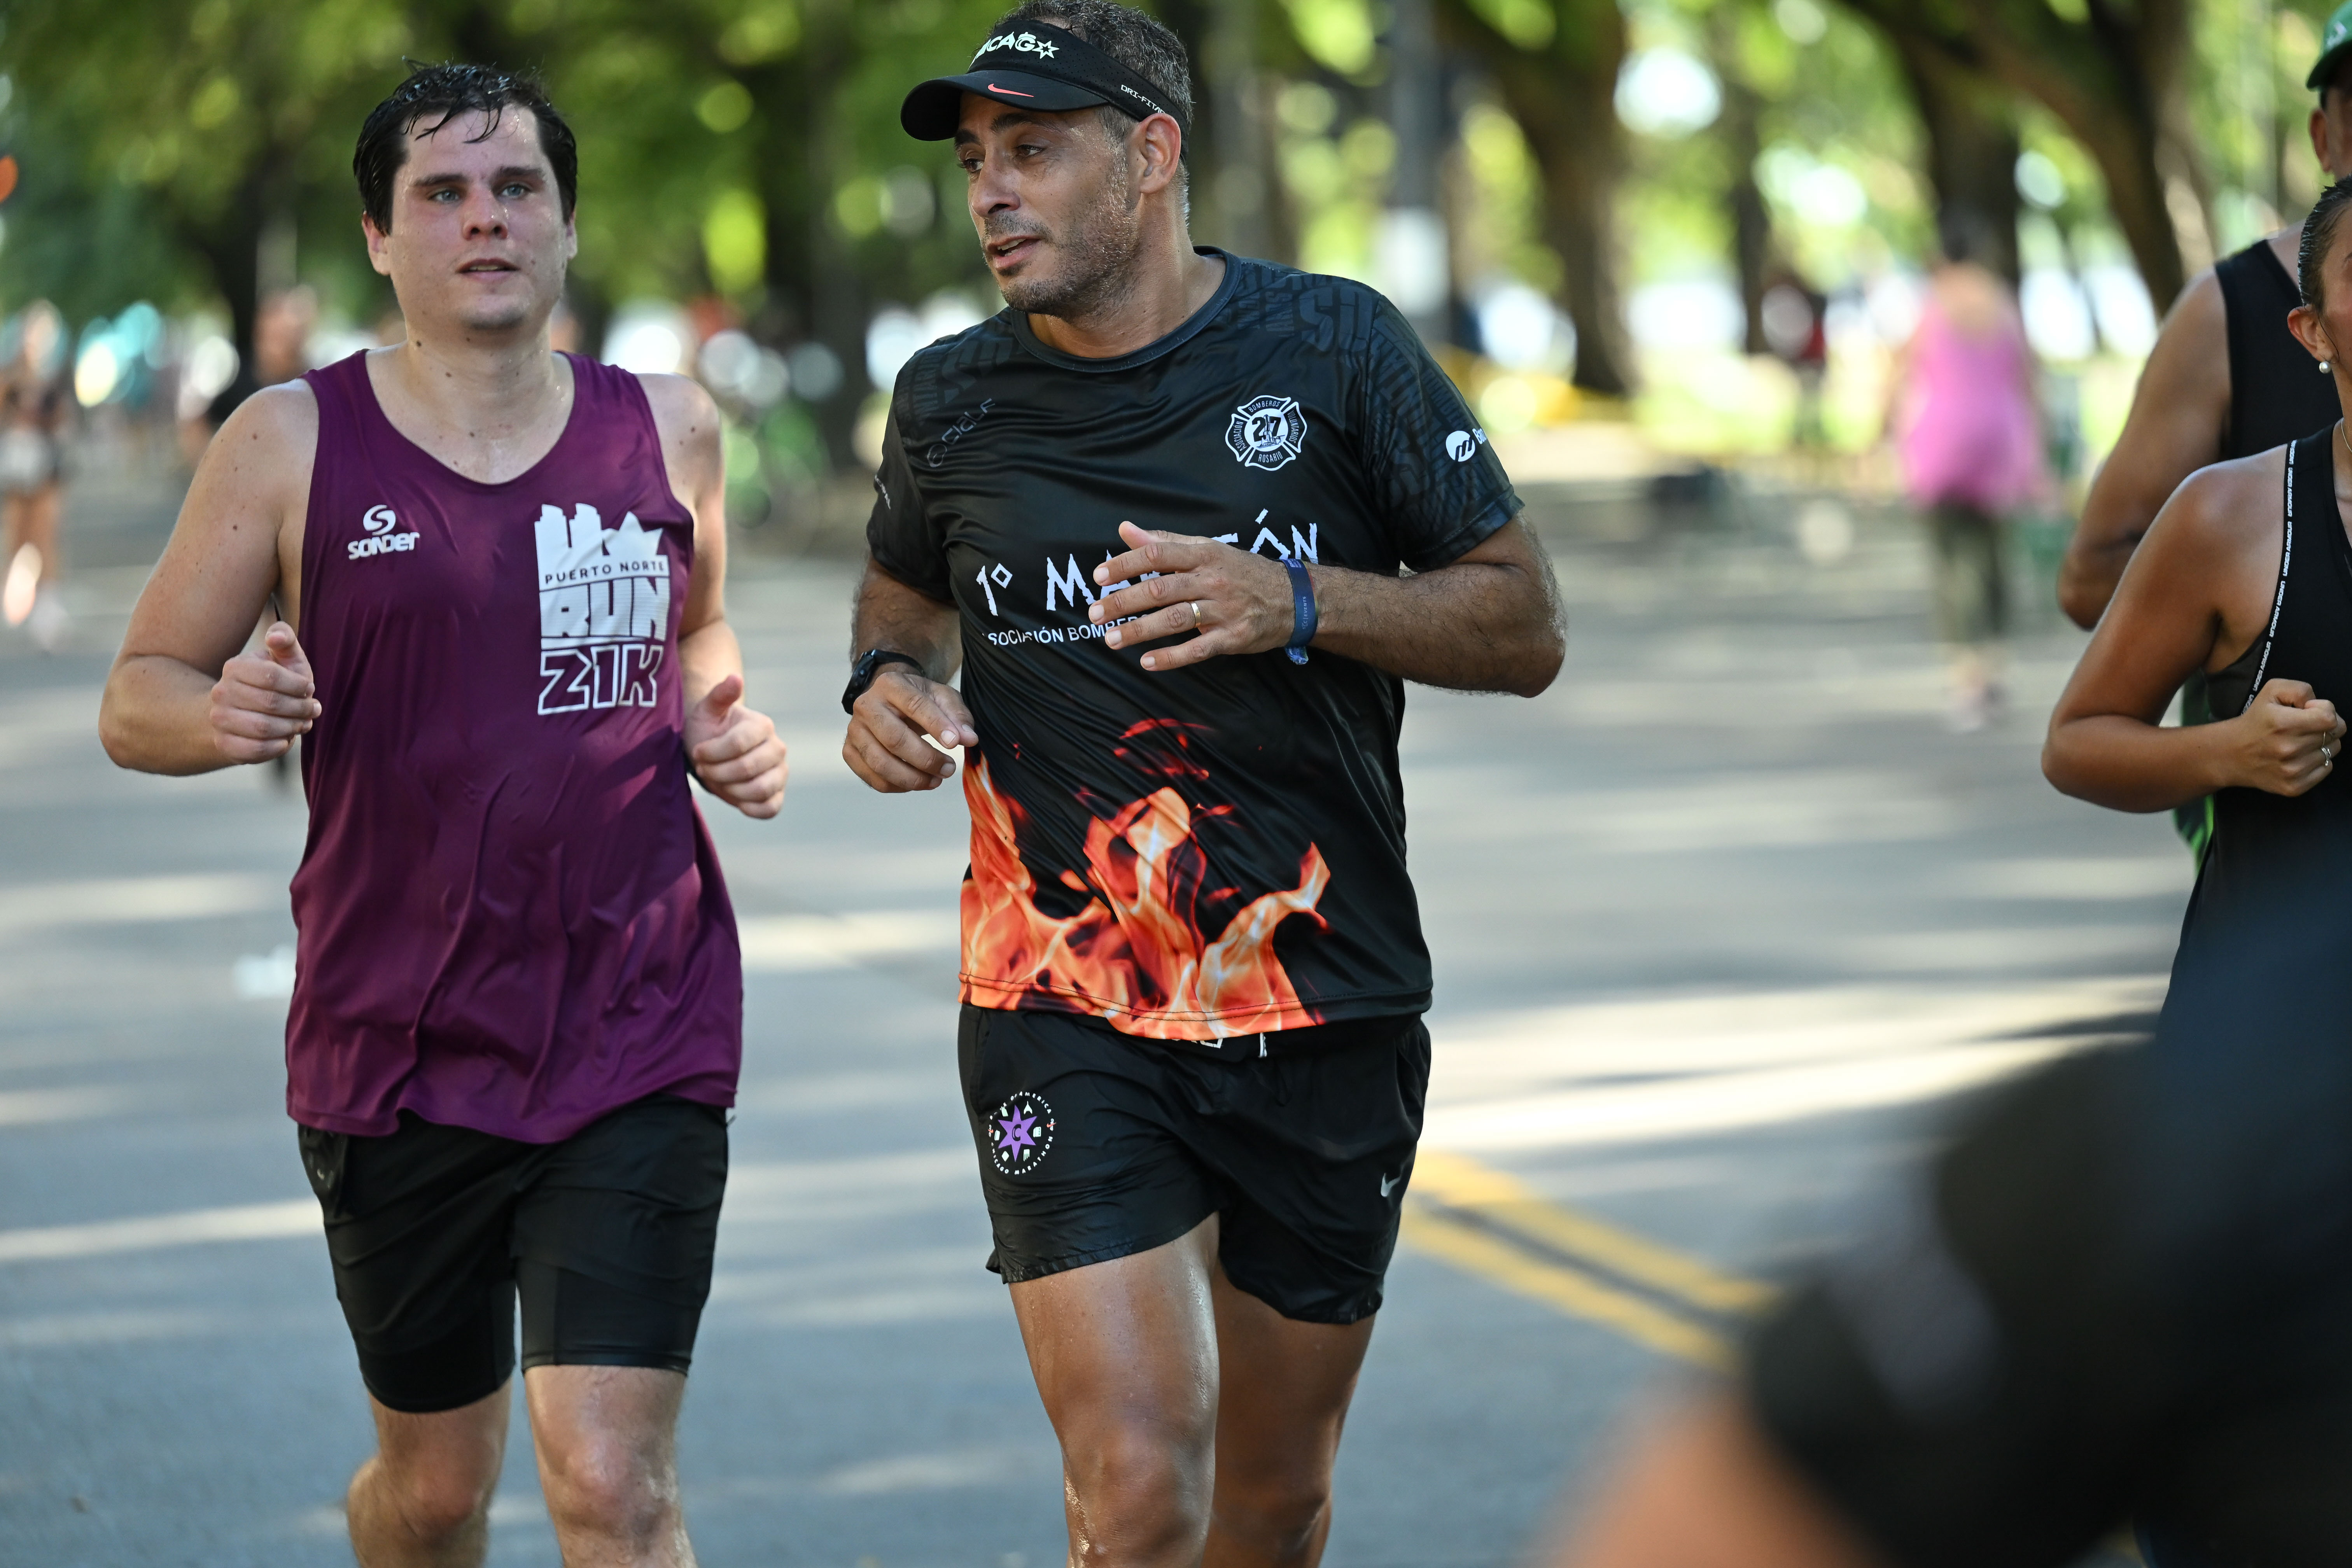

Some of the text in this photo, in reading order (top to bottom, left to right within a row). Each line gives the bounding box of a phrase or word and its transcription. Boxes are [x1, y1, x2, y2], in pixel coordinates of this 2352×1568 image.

[1248, 400, 1280, 412] BOMBEROS
[1233, 420, 1247, 452] ASOCIACIÓN
[1252, 416, 1281, 442] 27
[1287, 410, 1299, 444] VOLUNTARIOS
[1258, 451, 1283, 463] ROSARIO
[545, 561, 664, 584] PUERTO NORTE
[539, 576, 670, 641] RUN
[2269, 606, 2280, 637] ARMOUR
[1019, 1091, 1052, 1114] AMERICA
[1014, 1136, 1053, 1175] MARATHON
